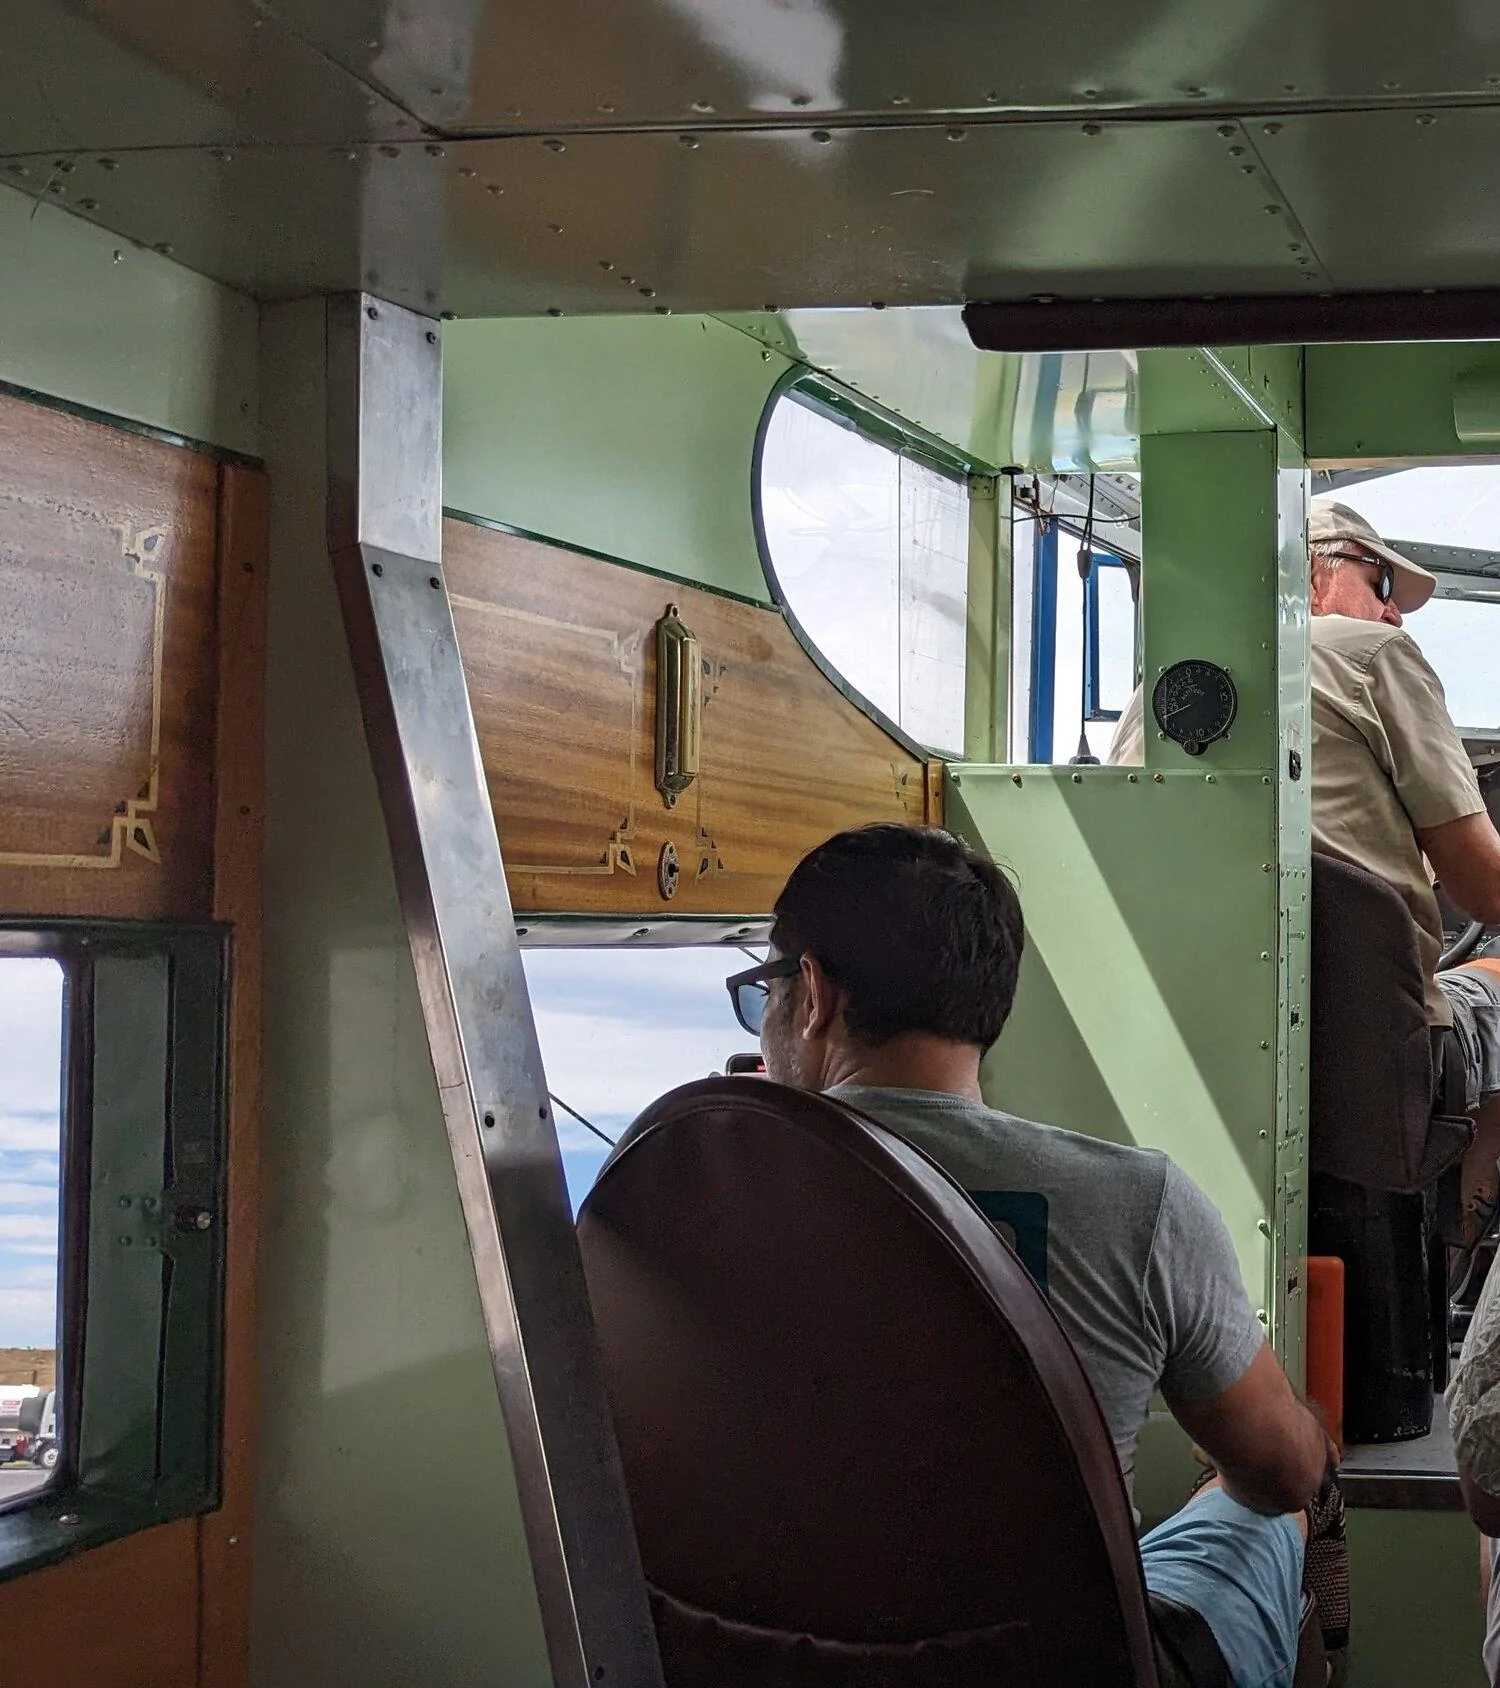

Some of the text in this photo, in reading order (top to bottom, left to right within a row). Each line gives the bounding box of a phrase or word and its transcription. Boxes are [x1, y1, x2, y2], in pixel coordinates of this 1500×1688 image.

[1220, 692, 1228, 702] 15
[1168, 702, 1178, 711] 25
[1196, 728, 1204, 737] 10
